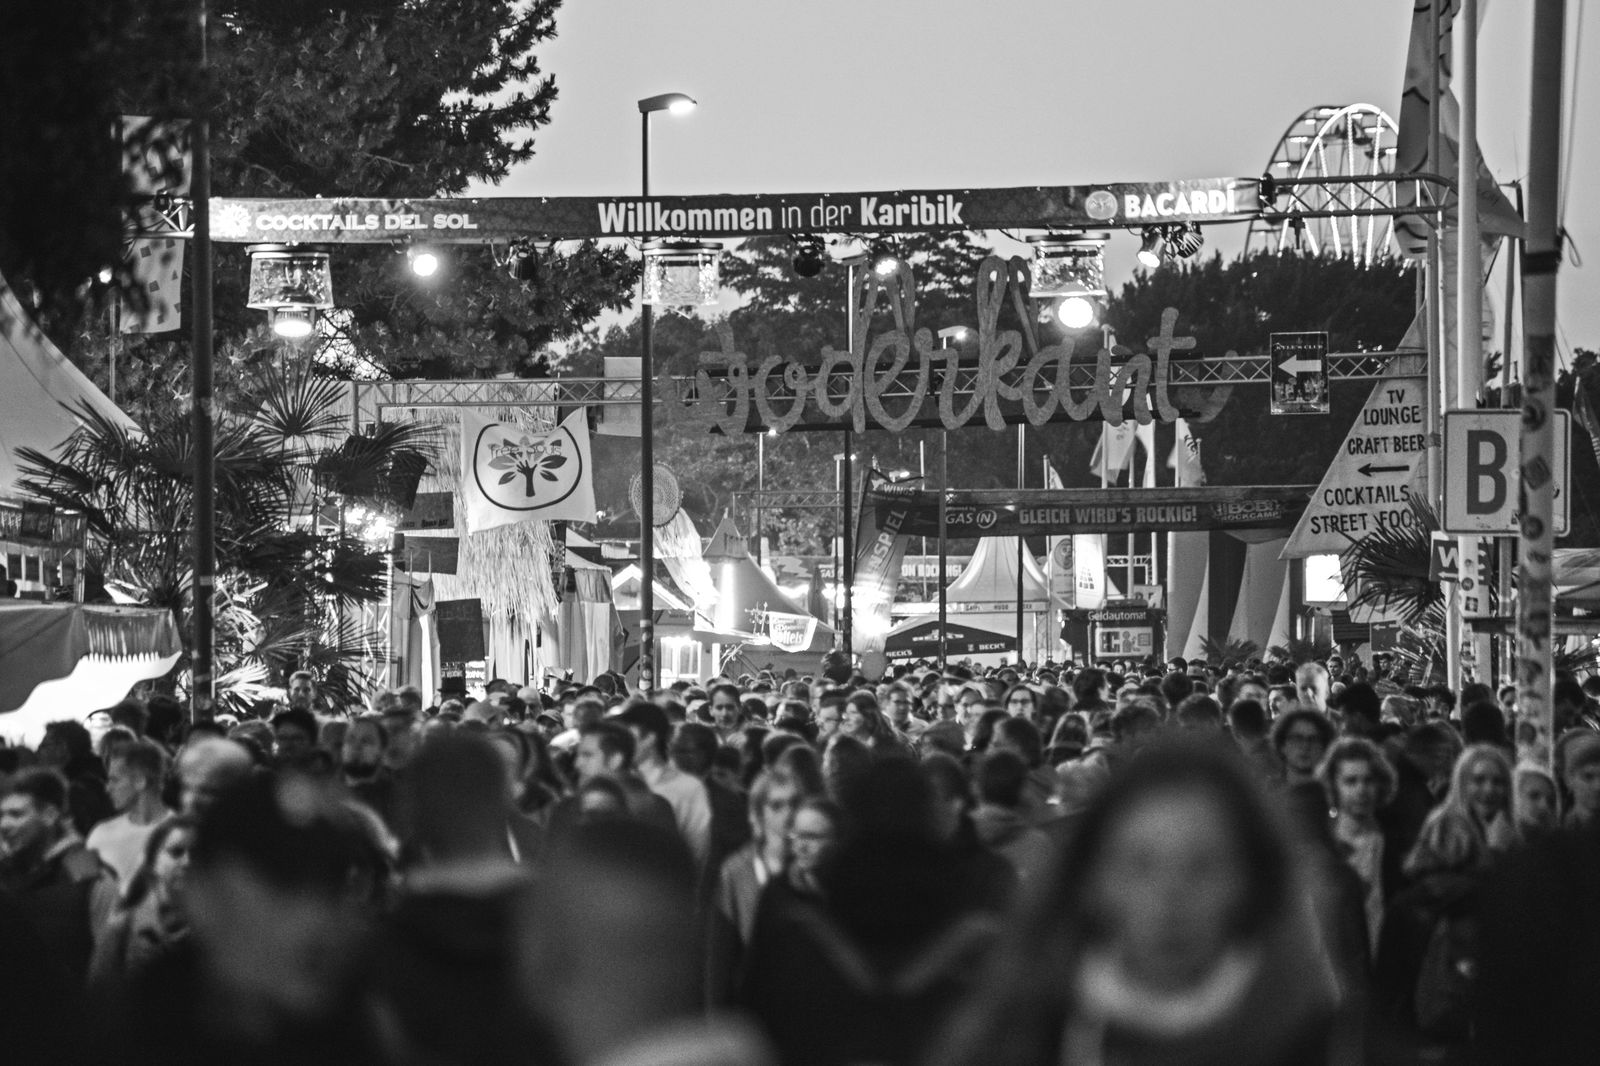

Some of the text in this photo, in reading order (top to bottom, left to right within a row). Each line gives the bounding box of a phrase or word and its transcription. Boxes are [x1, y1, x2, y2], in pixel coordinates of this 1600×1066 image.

[255, 213, 478, 231] COCKTAILS DEL SOL
[598, 195, 964, 233] Willkommen in der Karibik
[1387, 389, 1405, 404] TV
[1363, 405, 1422, 426] LOUNGE
[1348, 433, 1426, 456] CRAFT BEER
[1466, 428, 1508, 515] B
[1324, 484, 1411, 507] COCKTAILS
[944, 512, 974, 525] GAS
[1019, 506, 1198, 525] GLEICH WIRD'S ROCKIG!
[1310, 509, 1414, 534] STREET FOO
[1087, 610, 1147, 621] Geldautomat
